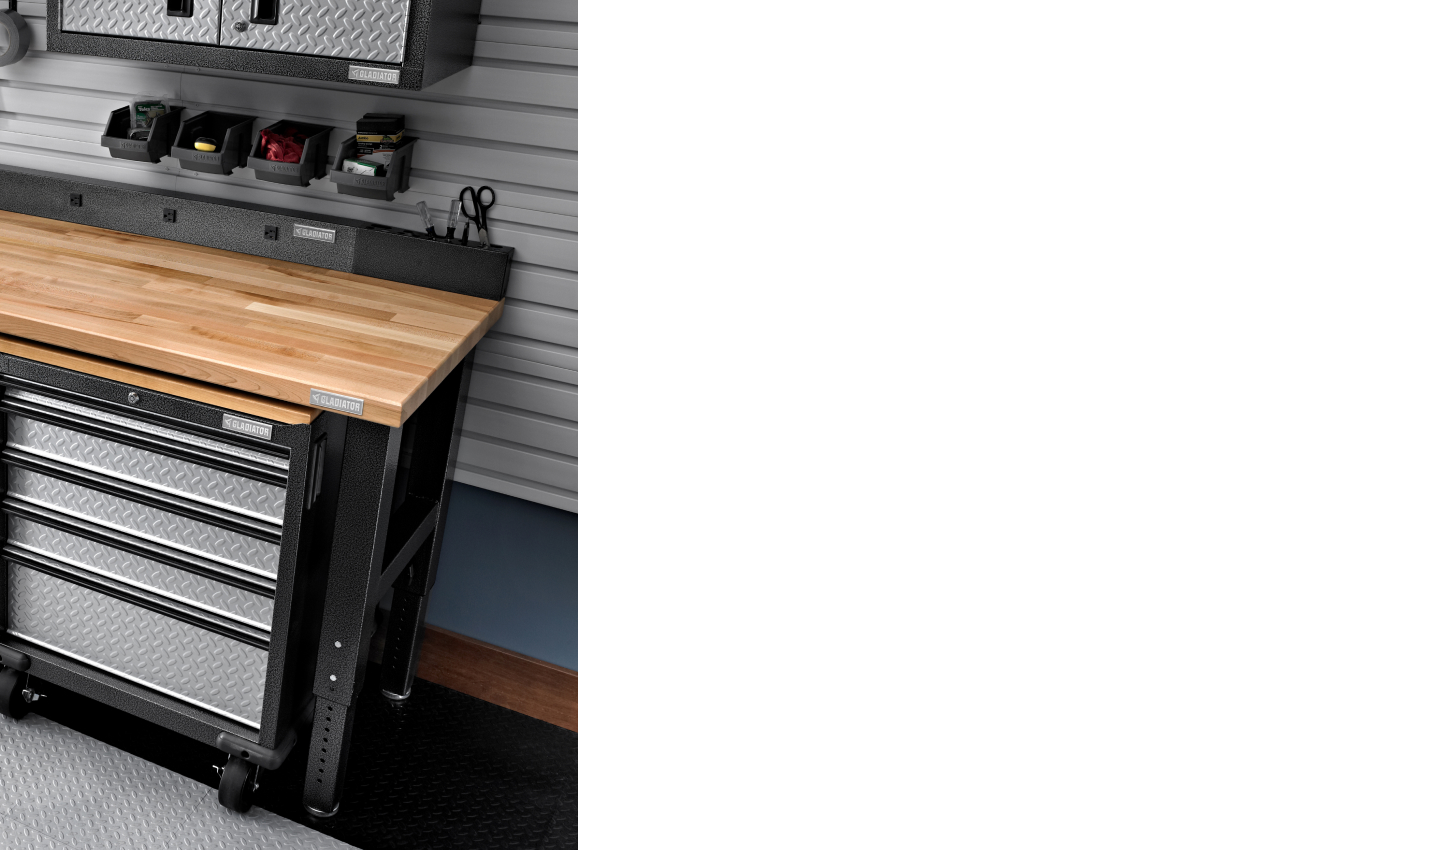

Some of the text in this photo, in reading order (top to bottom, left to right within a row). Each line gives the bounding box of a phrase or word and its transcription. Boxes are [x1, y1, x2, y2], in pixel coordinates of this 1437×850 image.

[359, 70, 397, 81] GLADIATOR
[302, 229, 333, 240] GLADIATOR
[320, 395, 361, 412] GLADIATOR
[232, 420, 269, 437] GLADIATOR
